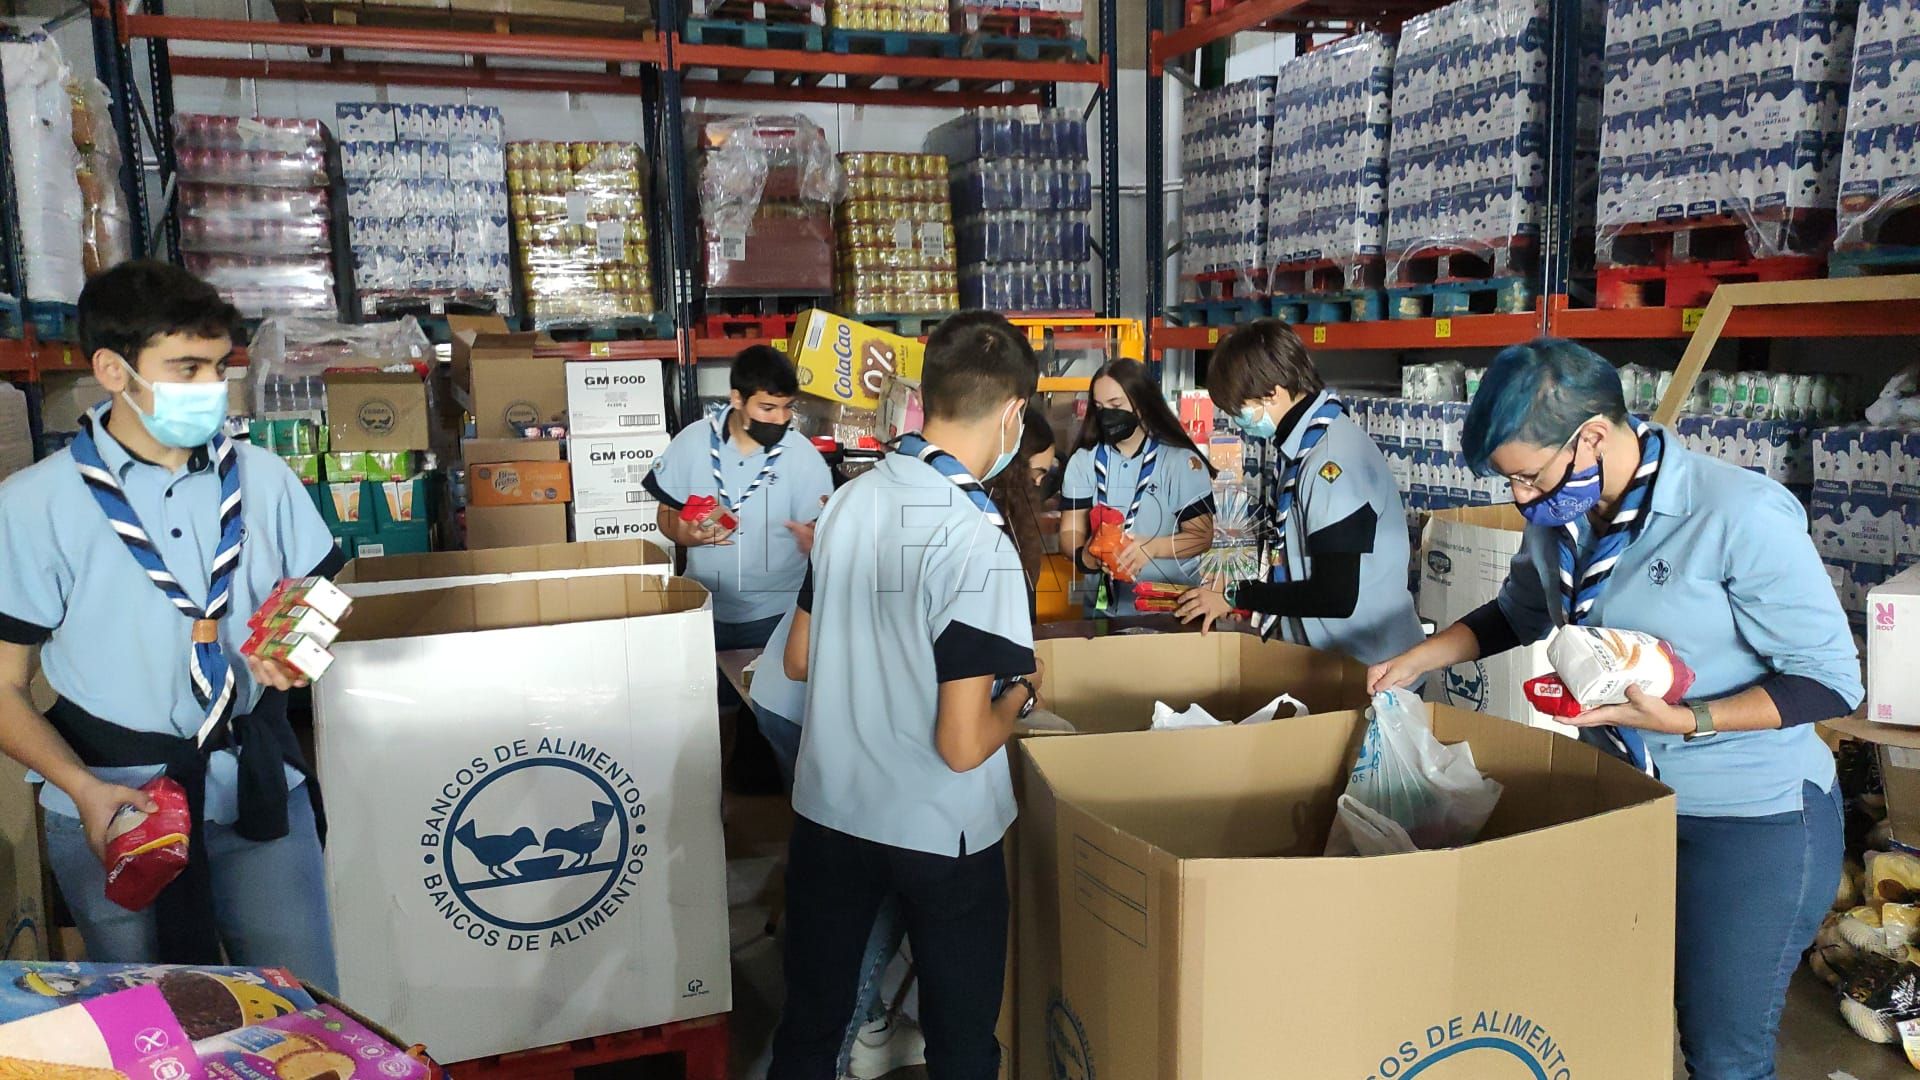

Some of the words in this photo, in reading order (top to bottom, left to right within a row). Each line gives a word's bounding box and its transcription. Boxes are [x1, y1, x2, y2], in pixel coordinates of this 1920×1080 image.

[584, 376, 610, 386] GM
[613, 375, 646, 385] FOOD
[833, 323, 852, 399] ColaCao
[863, 345, 894, 393] 0%
[590, 451, 616, 461] GM
[620, 449, 654, 460] FOOD
[593, 525, 620, 536] GM
[623, 522, 657, 534] FOOD
[421, 757, 489, 847] BANCOS
[494, 739, 529, 763] DE
[537, 737, 646, 819] ALIMENTOS
[423, 873, 500, 947] BANCOS
[507, 934, 540, 951] DE
[549, 844, 648, 948] ALIMENTOS
[1426, 1016, 1464, 1049] DE
[1471, 1010, 1571, 1080] ALIMENTO
